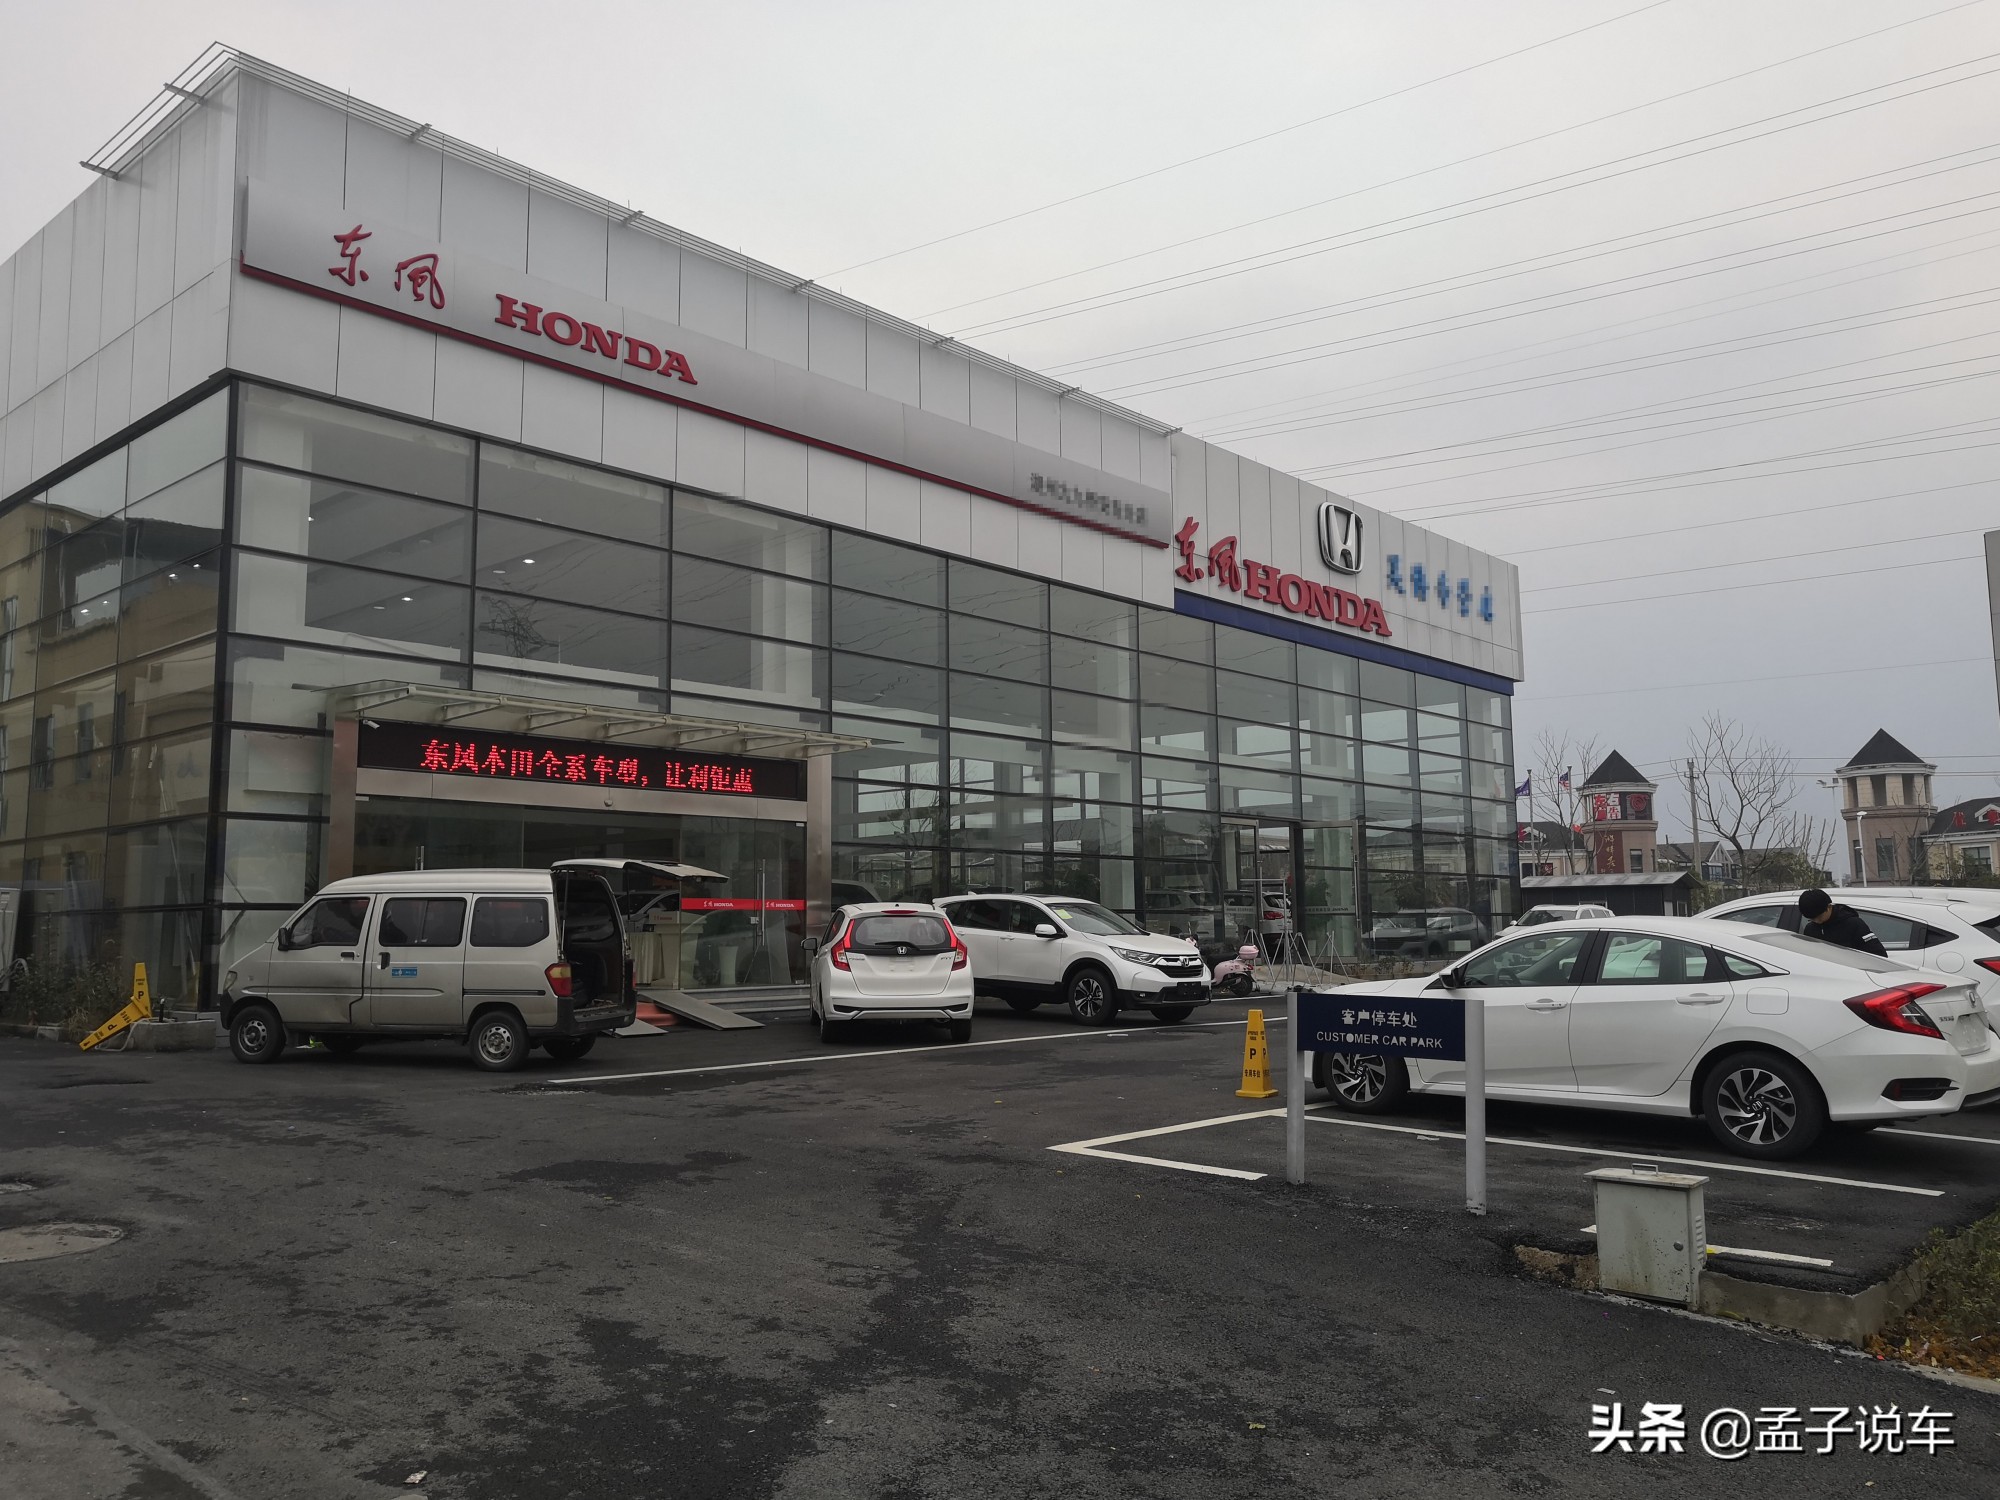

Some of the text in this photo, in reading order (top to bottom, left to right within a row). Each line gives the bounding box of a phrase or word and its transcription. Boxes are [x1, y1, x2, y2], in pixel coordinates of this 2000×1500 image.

[494, 294, 698, 385] HONDA
[1243, 559, 1392, 637] HONDA
[1341, 1008, 1417, 1028] 客户停车处
[1316, 1031, 1443, 1049] CUSTOMER CAR PARK
[1249, 1047, 1257, 1060] P
